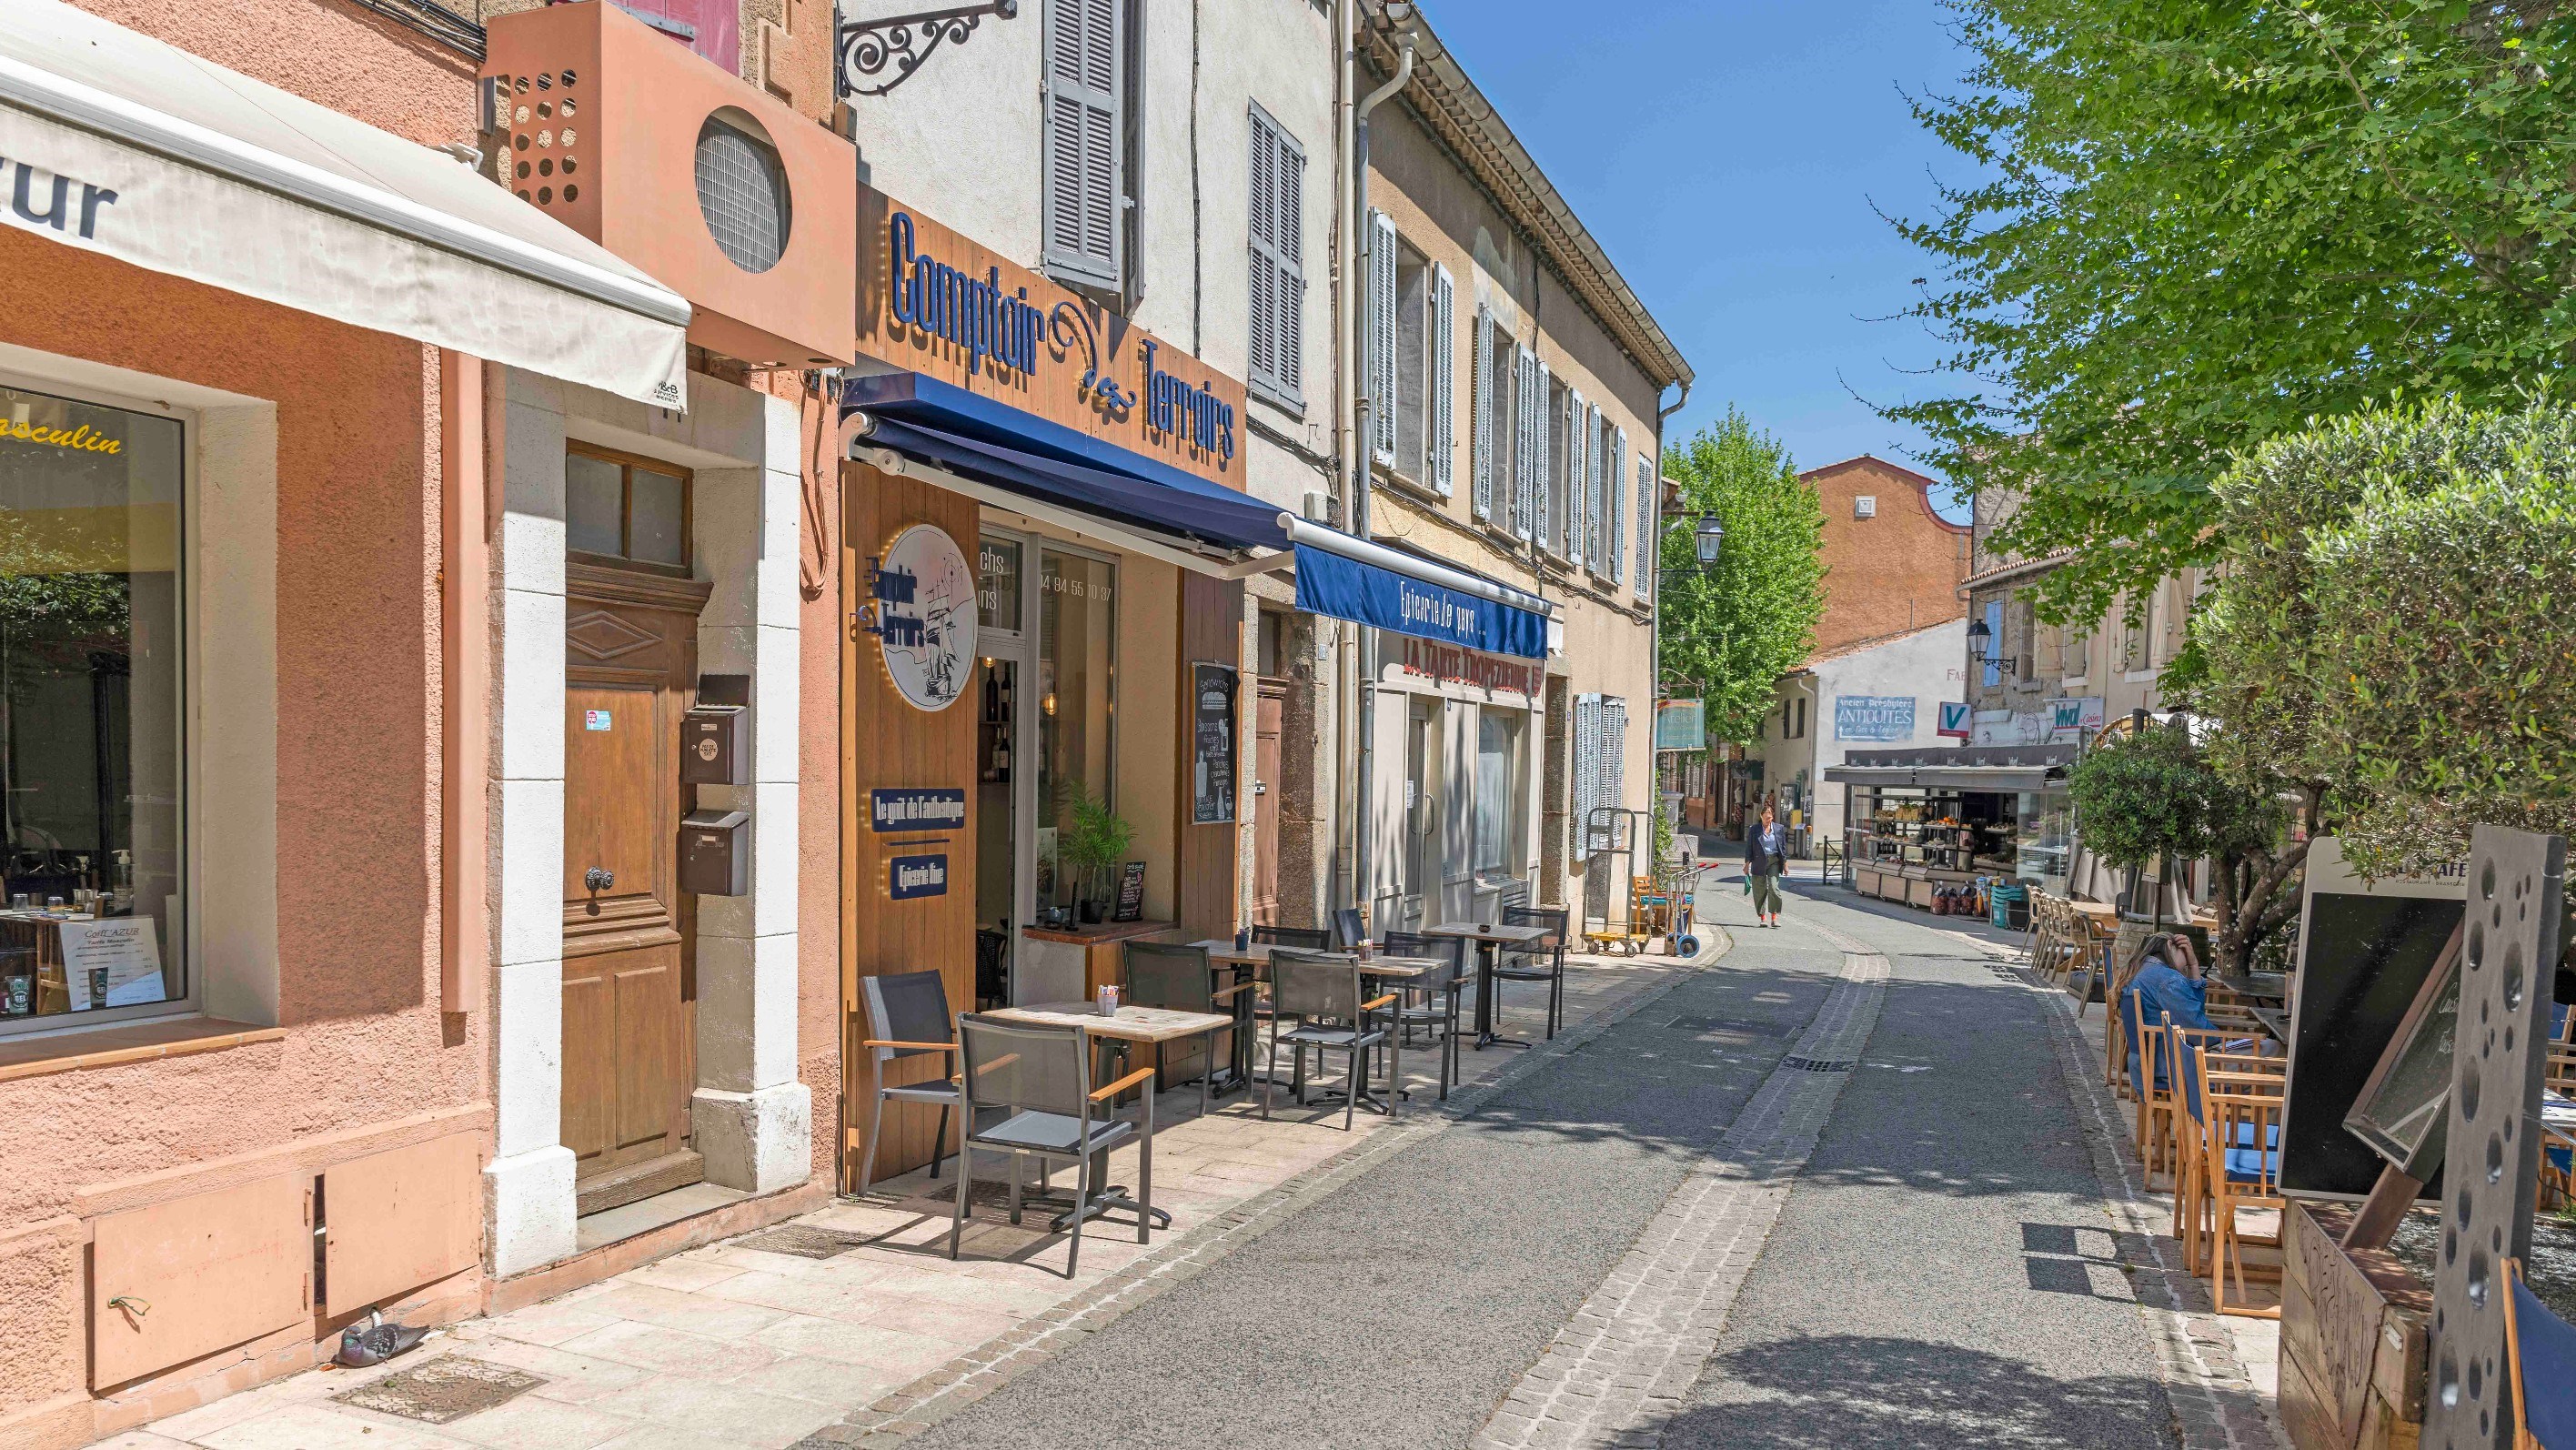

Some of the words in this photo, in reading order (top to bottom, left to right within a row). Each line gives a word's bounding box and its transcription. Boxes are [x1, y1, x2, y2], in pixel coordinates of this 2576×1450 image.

[0, 156, 118, 240] ur
[891, 212, 1045, 376] Comptoir
[1142, 338, 1234, 460] Terroirs
[1072, 580, 1083, 597] 55
[1088, 583, 1097, 599] 10
[1101, 587, 1112, 602] 37
[1400, 581, 1439, 626] Epicerie
[1441, 593, 1453, 628] de
[1456, 606, 1474, 639] pays
[1404, 638, 1421, 676] LA
[1424, 637, 1461, 684] TARTE
[1946, 706, 1967, 729] V
[876, 796, 887, 821] Le
[907, 797, 918, 819] de
[899, 864, 929, 891] Epicerie
[929, 862, 944, 884] fine
[2430, 861, 2467, 877] AFE
